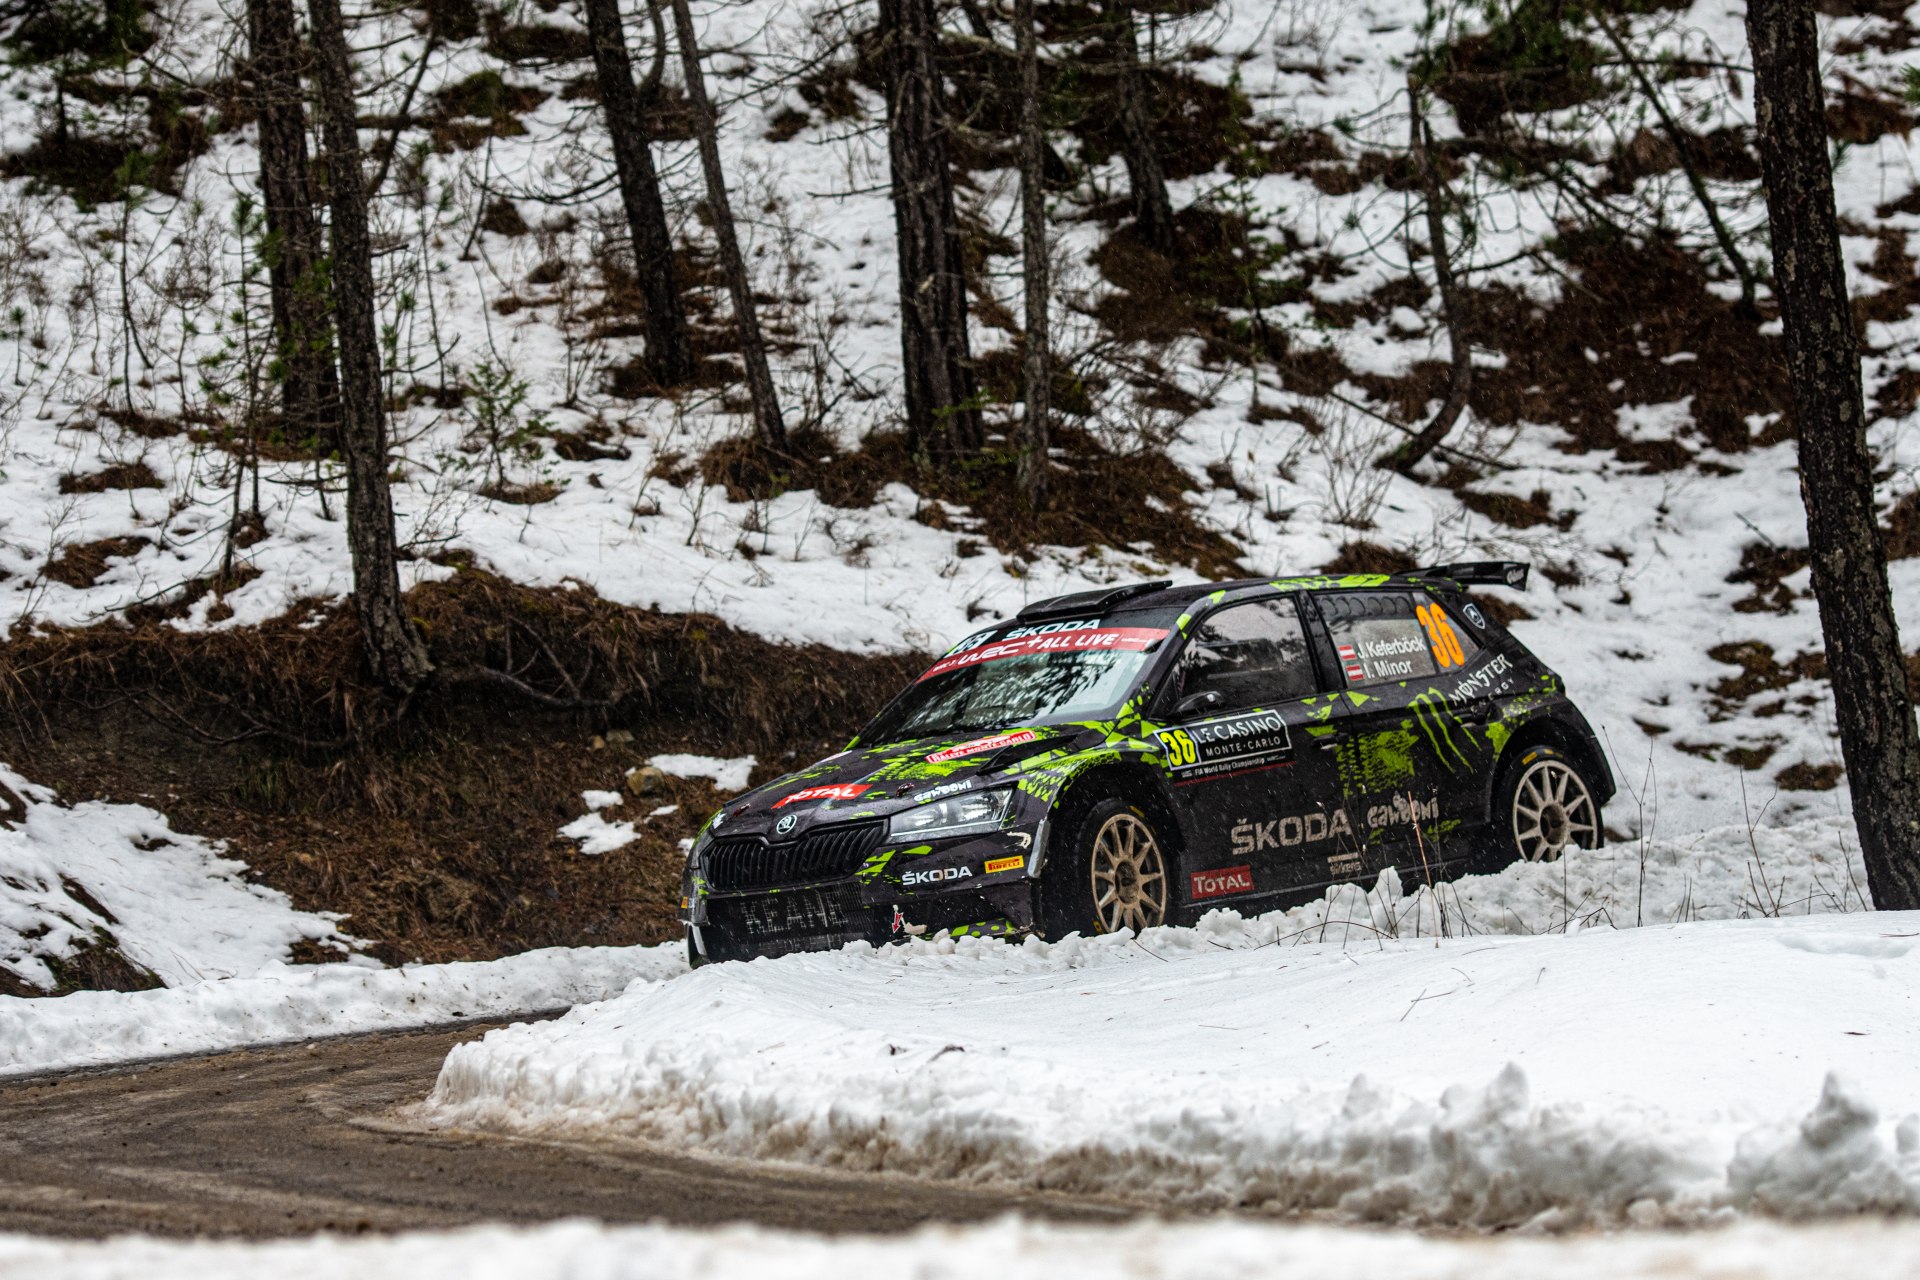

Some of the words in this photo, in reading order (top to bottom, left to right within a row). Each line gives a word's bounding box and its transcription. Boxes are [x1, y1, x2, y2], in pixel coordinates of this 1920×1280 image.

[1002, 618, 1100, 642] ŠKODA
[1415, 603, 1465, 668] 36
[1037, 635, 1069, 652] ALL
[1075, 633, 1119, 648] LIVE
[1374, 660, 1412, 677] Minor
[1192, 728, 1216, 744] LE
[1214, 716, 1282, 740] CASINO
[1159, 729, 1196, 767] 36
[1204, 764, 1219, 775] World
[1232, 757, 1265, 769] Championship
[784, 786, 856, 804] TOTAL
[1230, 808, 1353, 856] ŠKODA
[902, 865, 973, 886] ŠKODA
[1193, 872, 1251, 894] TOTAL
